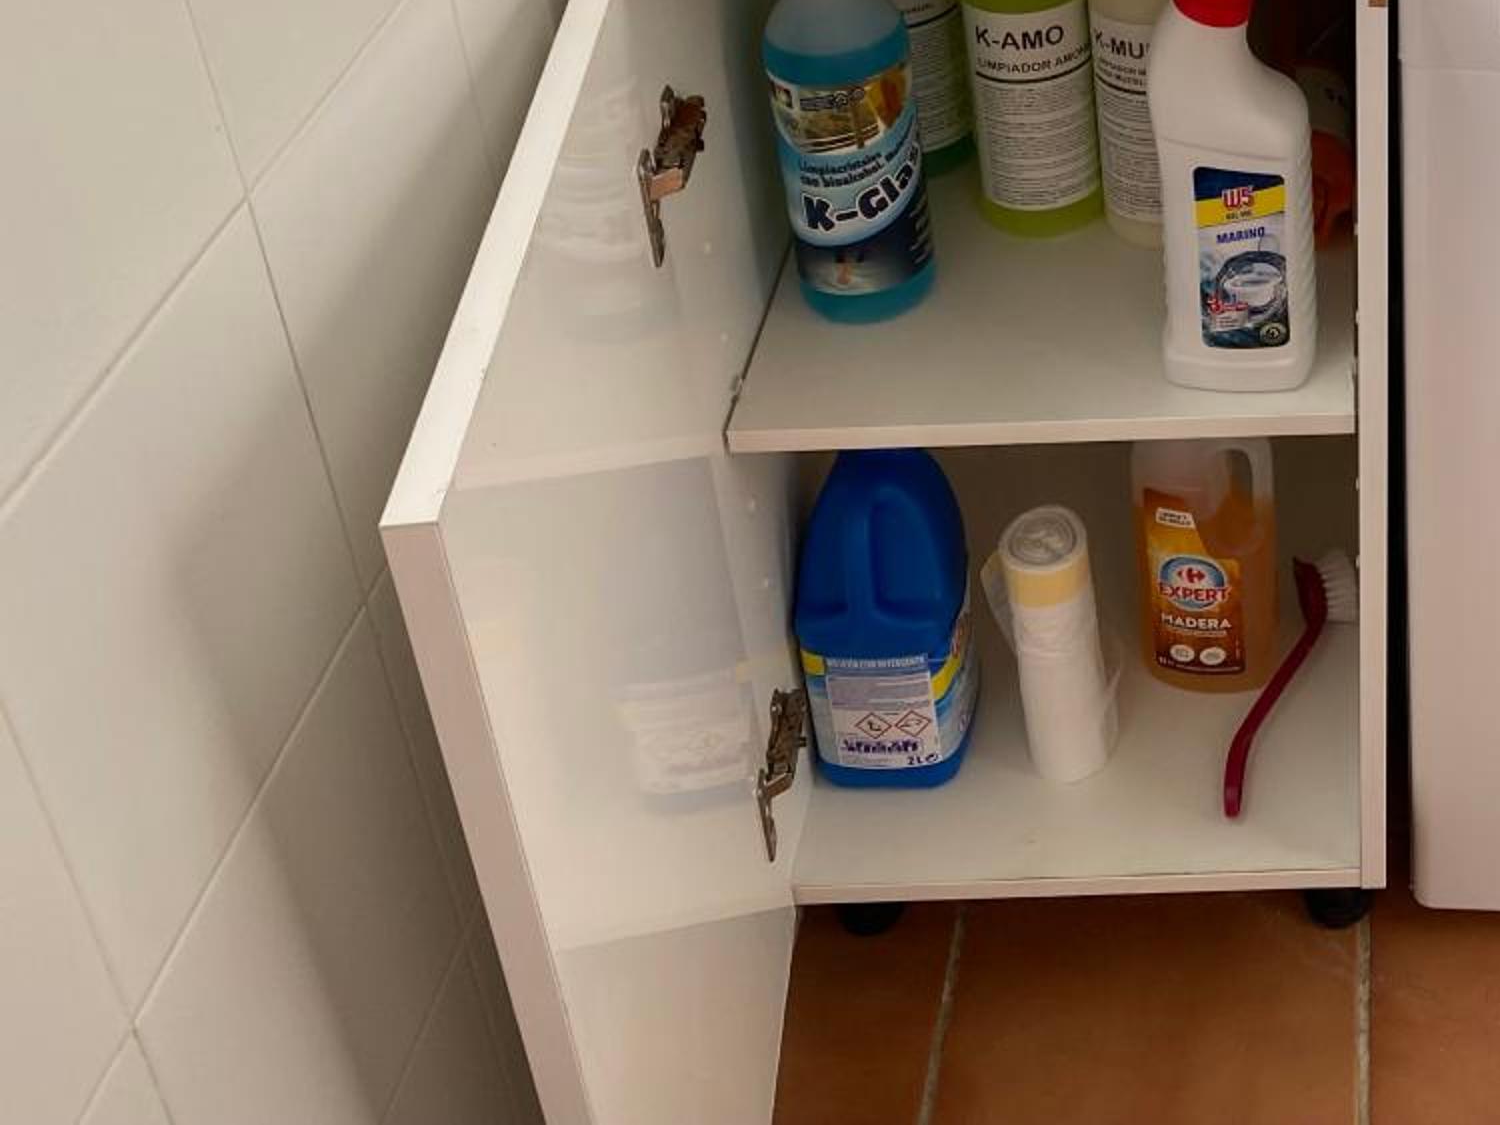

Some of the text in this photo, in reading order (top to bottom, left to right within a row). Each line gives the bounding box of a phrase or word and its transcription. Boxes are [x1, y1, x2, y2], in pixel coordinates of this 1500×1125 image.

[975, 24, 1065, 51] K-AMO
[976, 55, 1052, 74] LIMPIADOR
[1215, 225, 1266, 244] MARINO
[1157, 580, 1233, 604] EXPERT
[1160, 612, 1233, 630] MADERA
